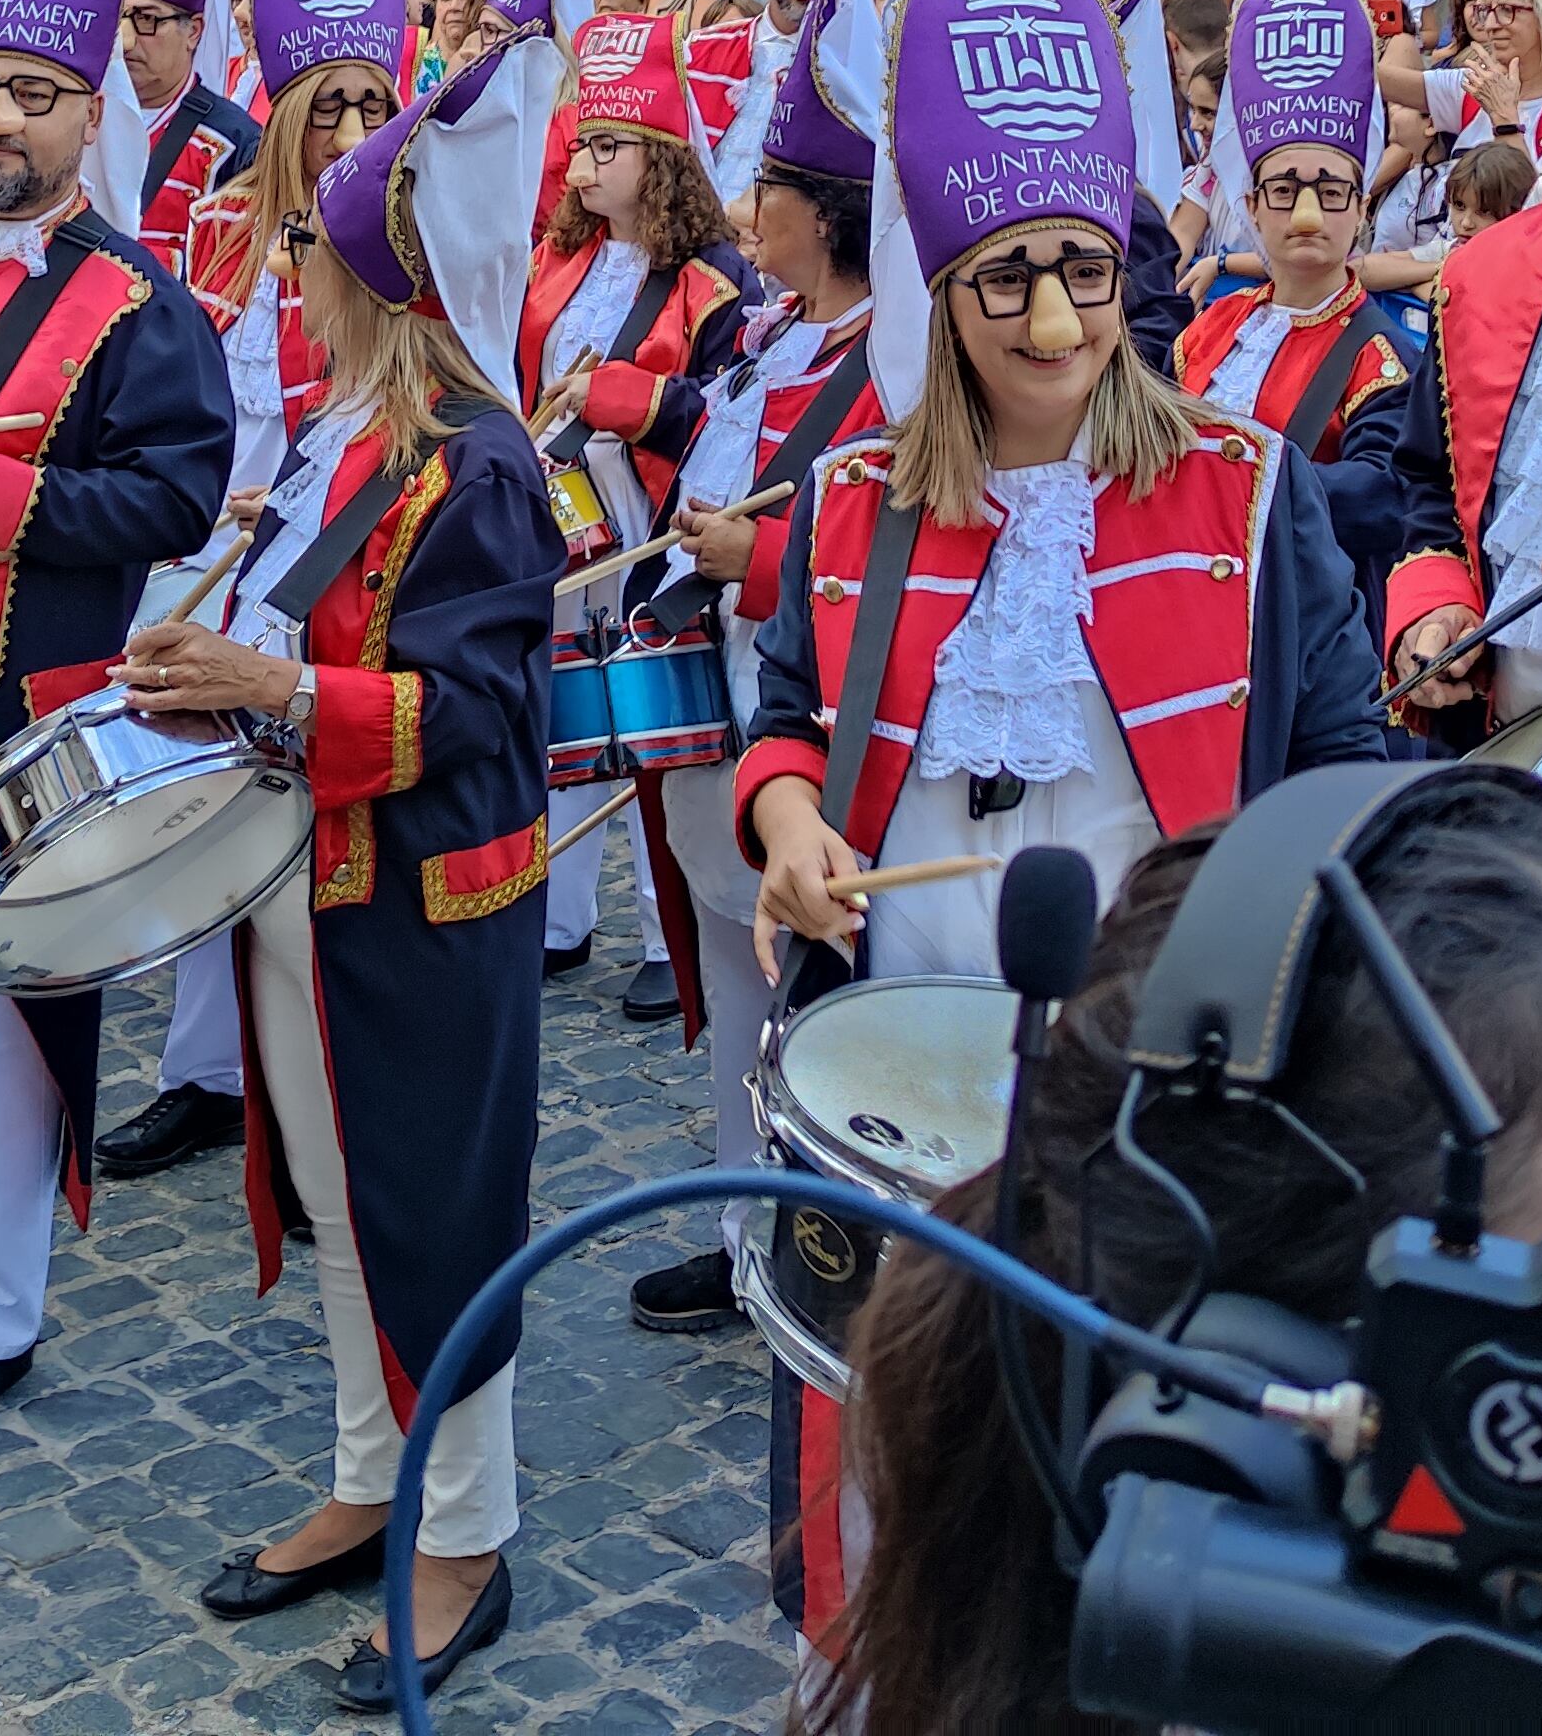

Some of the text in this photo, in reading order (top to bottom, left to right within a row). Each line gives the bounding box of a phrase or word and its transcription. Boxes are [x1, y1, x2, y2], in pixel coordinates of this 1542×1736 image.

[279, 20, 399, 54] AJUNTAMENT
[291, 40, 394, 71] DE GANDIA
[579, 85, 658, 105] NTAMENT
[1241, 94, 1364, 125] AJUNTAMENT
[580, 102, 643, 121] GANDIA
[1245, 117, 1356, 147] DE GANDIA
[943, 147, 1130, 196] AJUNTAMENT
[963, 178, 1123, 225] DE GANDIA
